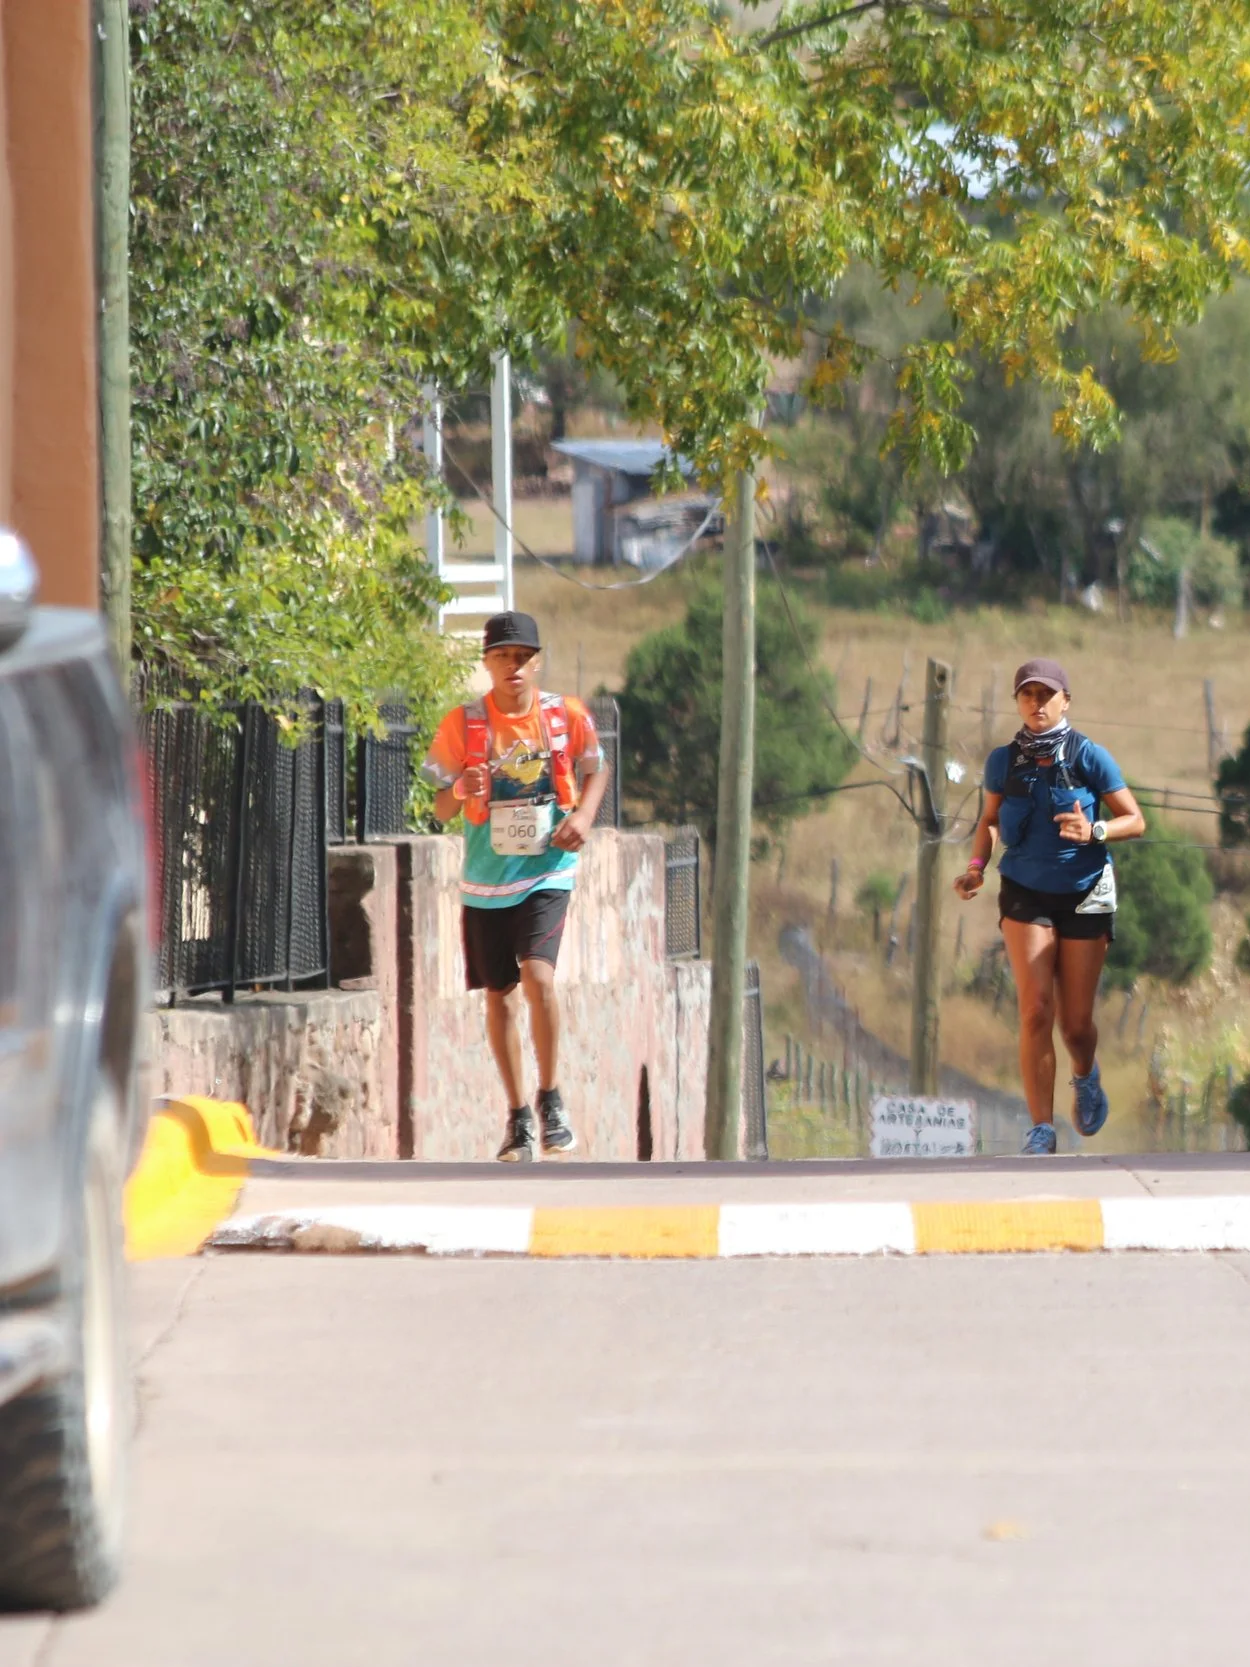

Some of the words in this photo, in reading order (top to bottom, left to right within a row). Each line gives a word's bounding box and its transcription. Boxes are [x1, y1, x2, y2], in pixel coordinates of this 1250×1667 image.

[507, 825, 537, 839] 060
[886, 1101, 926, 1114] CASA
[937, 1105, 956, 1117] DE
[913, 1129, 923, 1141] Y
